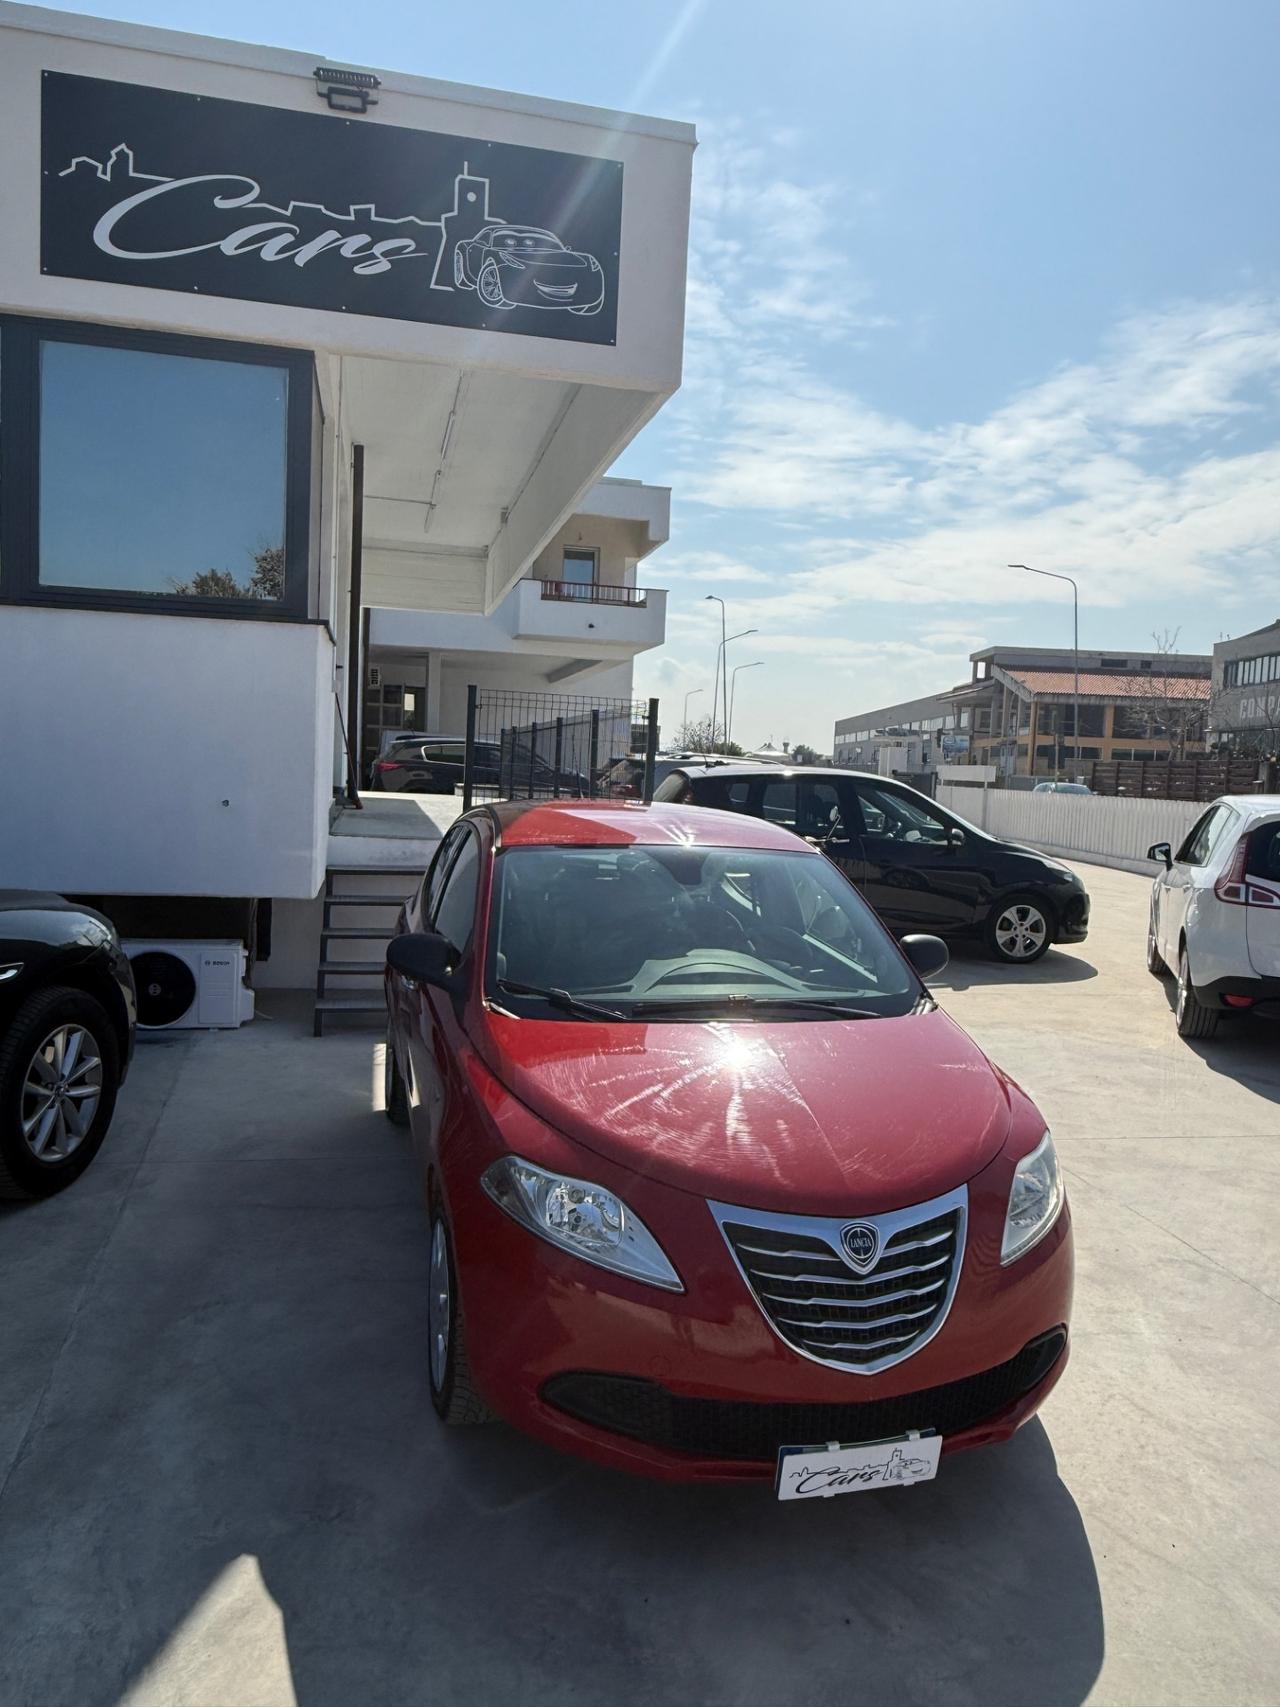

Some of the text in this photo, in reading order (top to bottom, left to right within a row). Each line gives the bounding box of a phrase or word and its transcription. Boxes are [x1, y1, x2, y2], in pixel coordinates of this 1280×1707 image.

[94, 174, 428, 275] Cars
[850, 1237, 872, 1248] LANCIA
[796, 1466, 881, 1494] Cars
